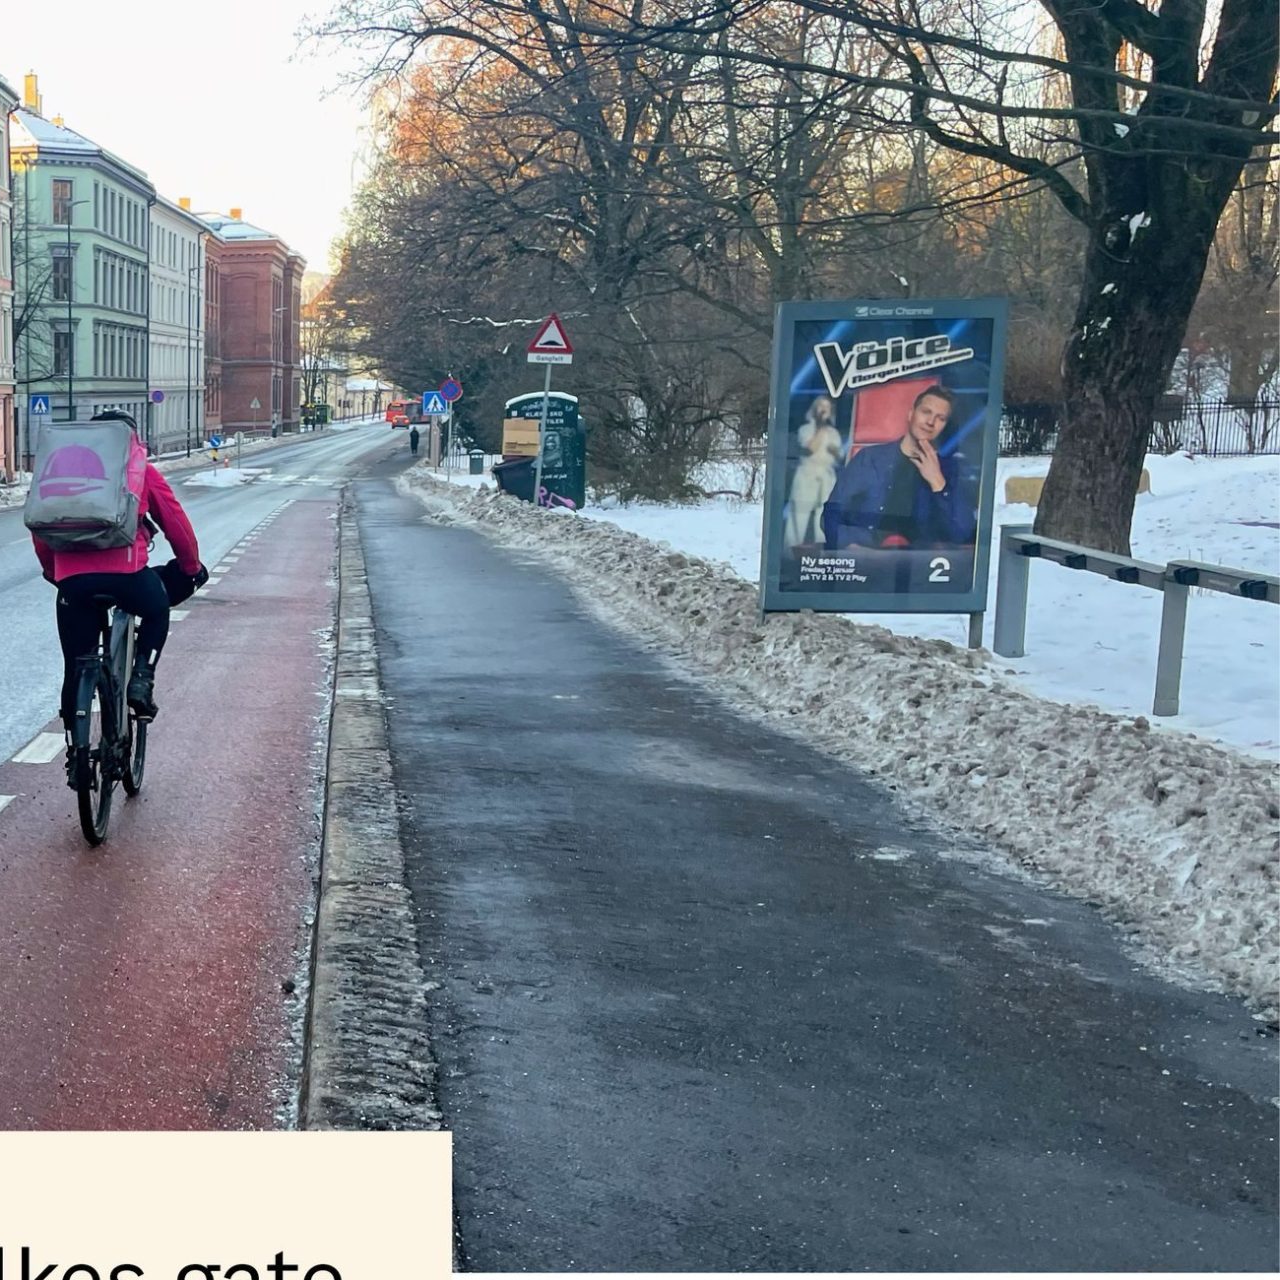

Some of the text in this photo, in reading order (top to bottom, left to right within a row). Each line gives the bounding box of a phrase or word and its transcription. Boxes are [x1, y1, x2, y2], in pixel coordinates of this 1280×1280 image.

[895, 306, 934, 316] Channel
[856, 342, 876, 353] the
[818, 336, 950, 395] Voice
[801, 556, 856, 567] Ny sesong
[928, 556, 951, 583] 2
